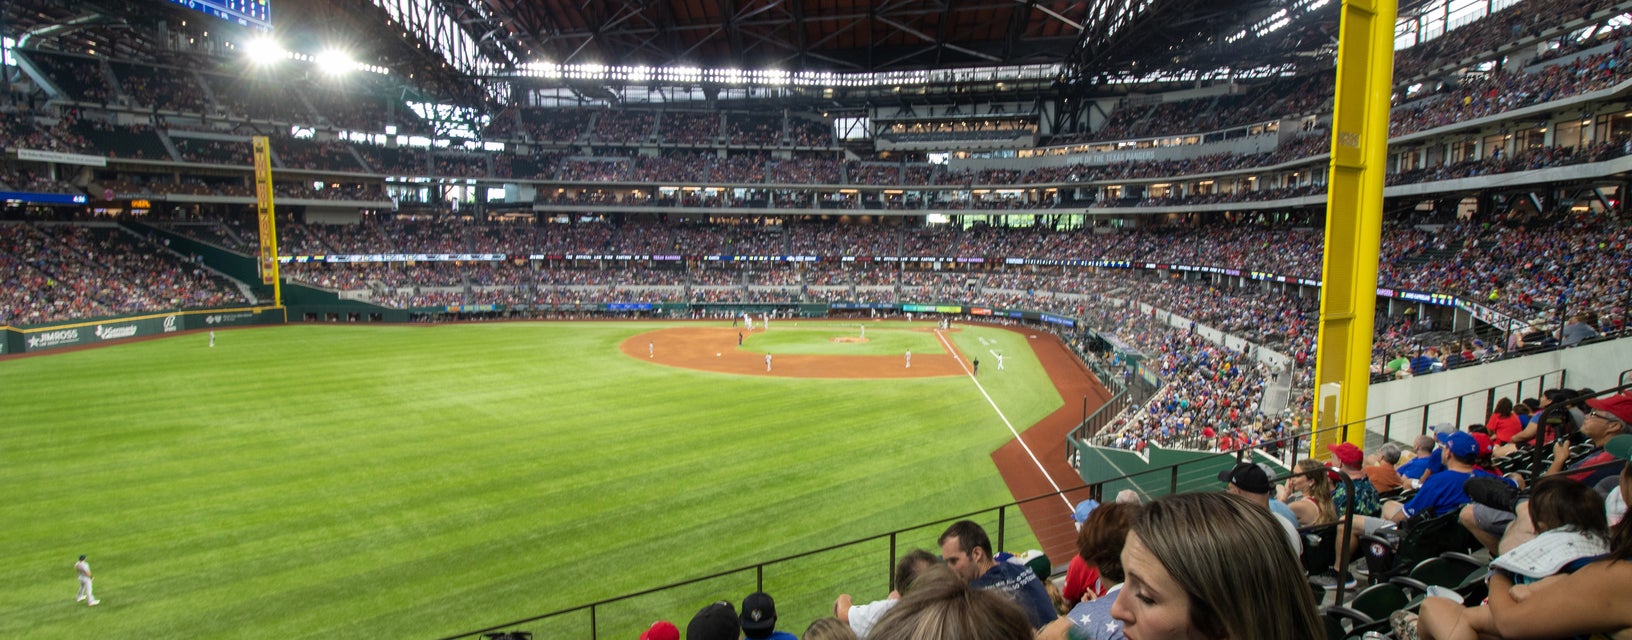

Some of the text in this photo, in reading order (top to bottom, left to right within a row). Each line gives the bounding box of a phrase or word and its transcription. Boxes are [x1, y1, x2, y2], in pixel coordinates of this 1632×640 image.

[1067, 151, 1155, 165] HOME OF THE TEXAS RANGERS
